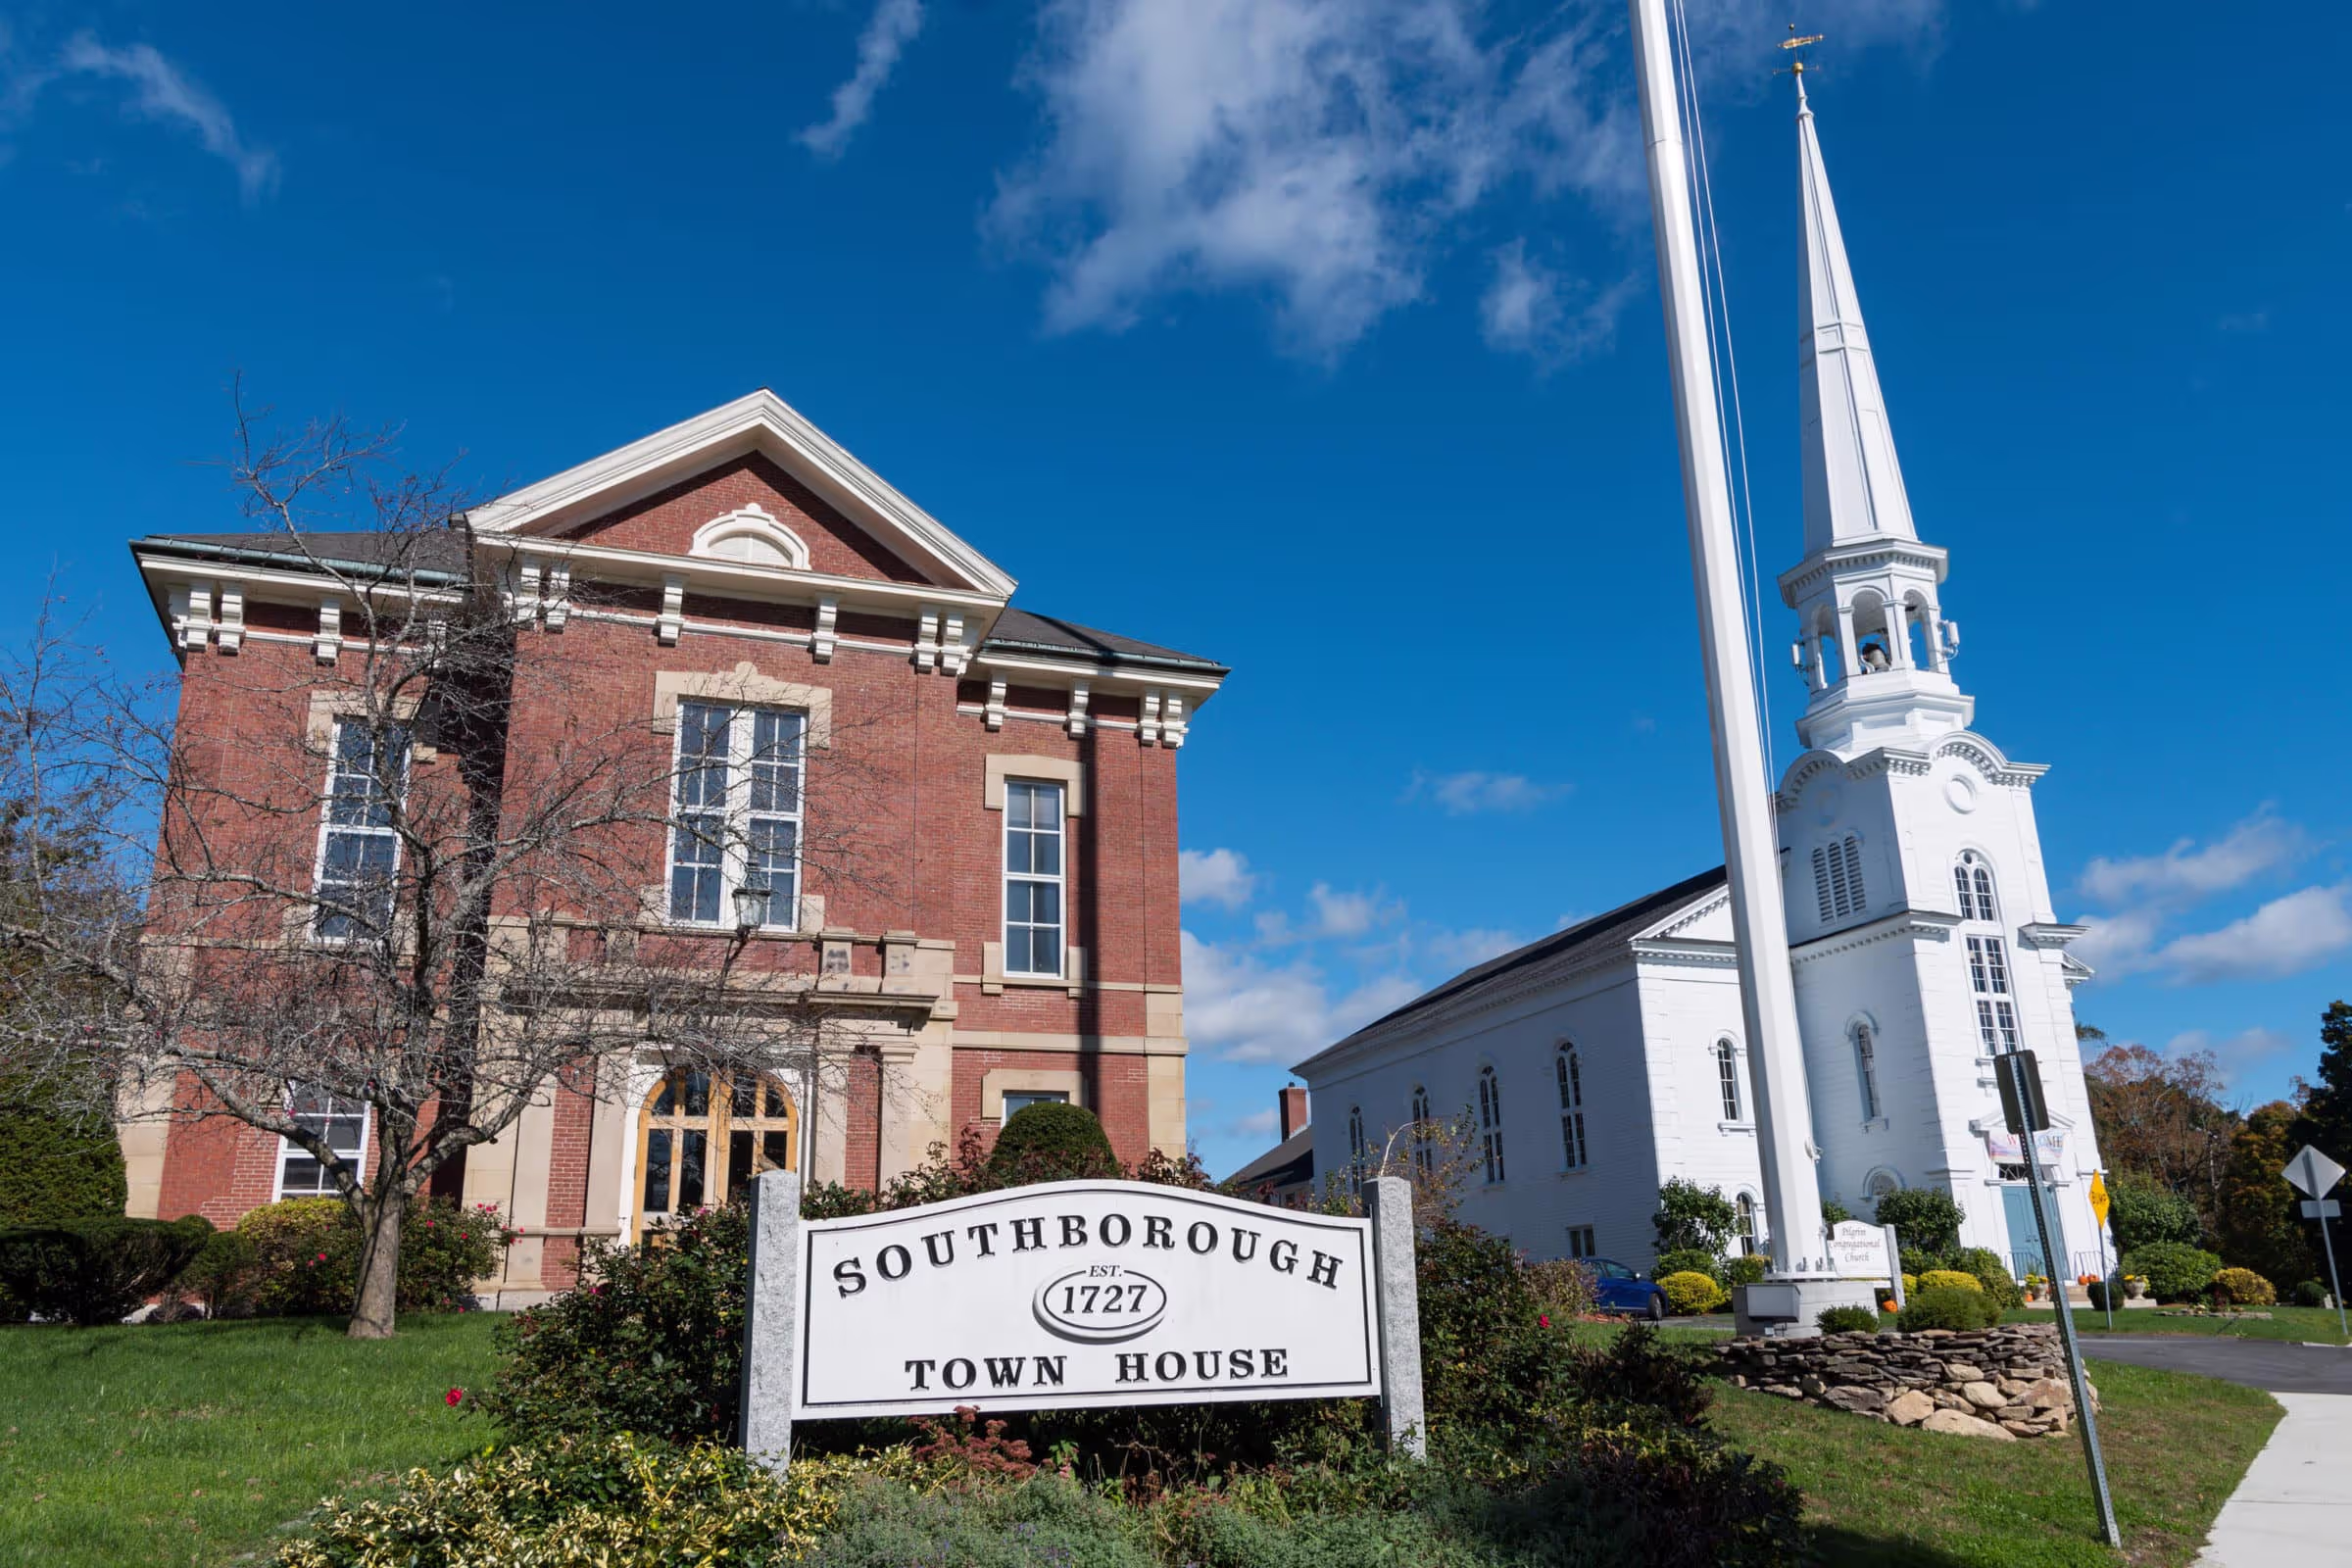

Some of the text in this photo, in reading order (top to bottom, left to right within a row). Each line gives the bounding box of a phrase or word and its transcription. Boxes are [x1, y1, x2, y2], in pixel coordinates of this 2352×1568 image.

[2007, 1134, 2063, 1148] WOME
[1842, 1226, 1866, 1240] Pilgrim
[832, 1213, 1344, 1299] SOUTHBOROUGH
[1844, 1251, 1869, 1263] Church
[1089, 1265, 1122, 1278] EST.
[1062, 1285, 1148, 1314] 1727
[905, 1348, 1289, 1392] TOWN HOUSE
